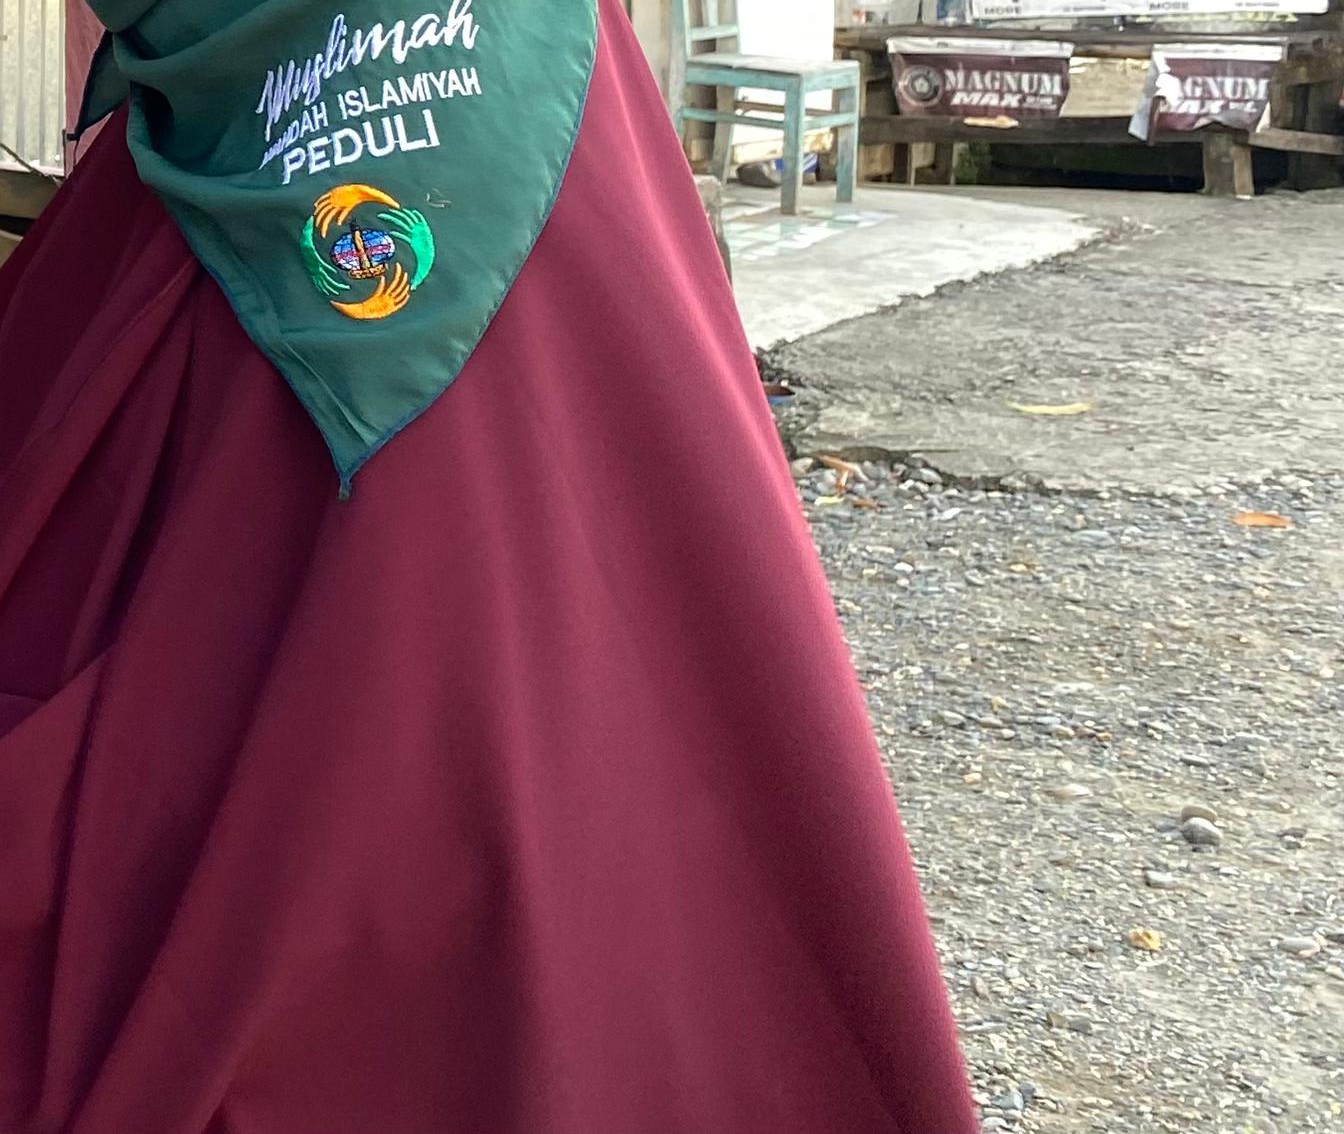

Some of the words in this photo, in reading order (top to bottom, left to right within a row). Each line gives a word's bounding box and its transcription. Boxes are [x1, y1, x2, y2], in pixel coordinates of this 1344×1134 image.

[337, 67, 482, 120] ISLAMIYAH
[944, 68, 1063, 95] MAGNUM
[1184, 76, 1271, 100] GNUM
[950, 91, 1025, 108] MAX
[282, 109, 441, 185] PEDULI
